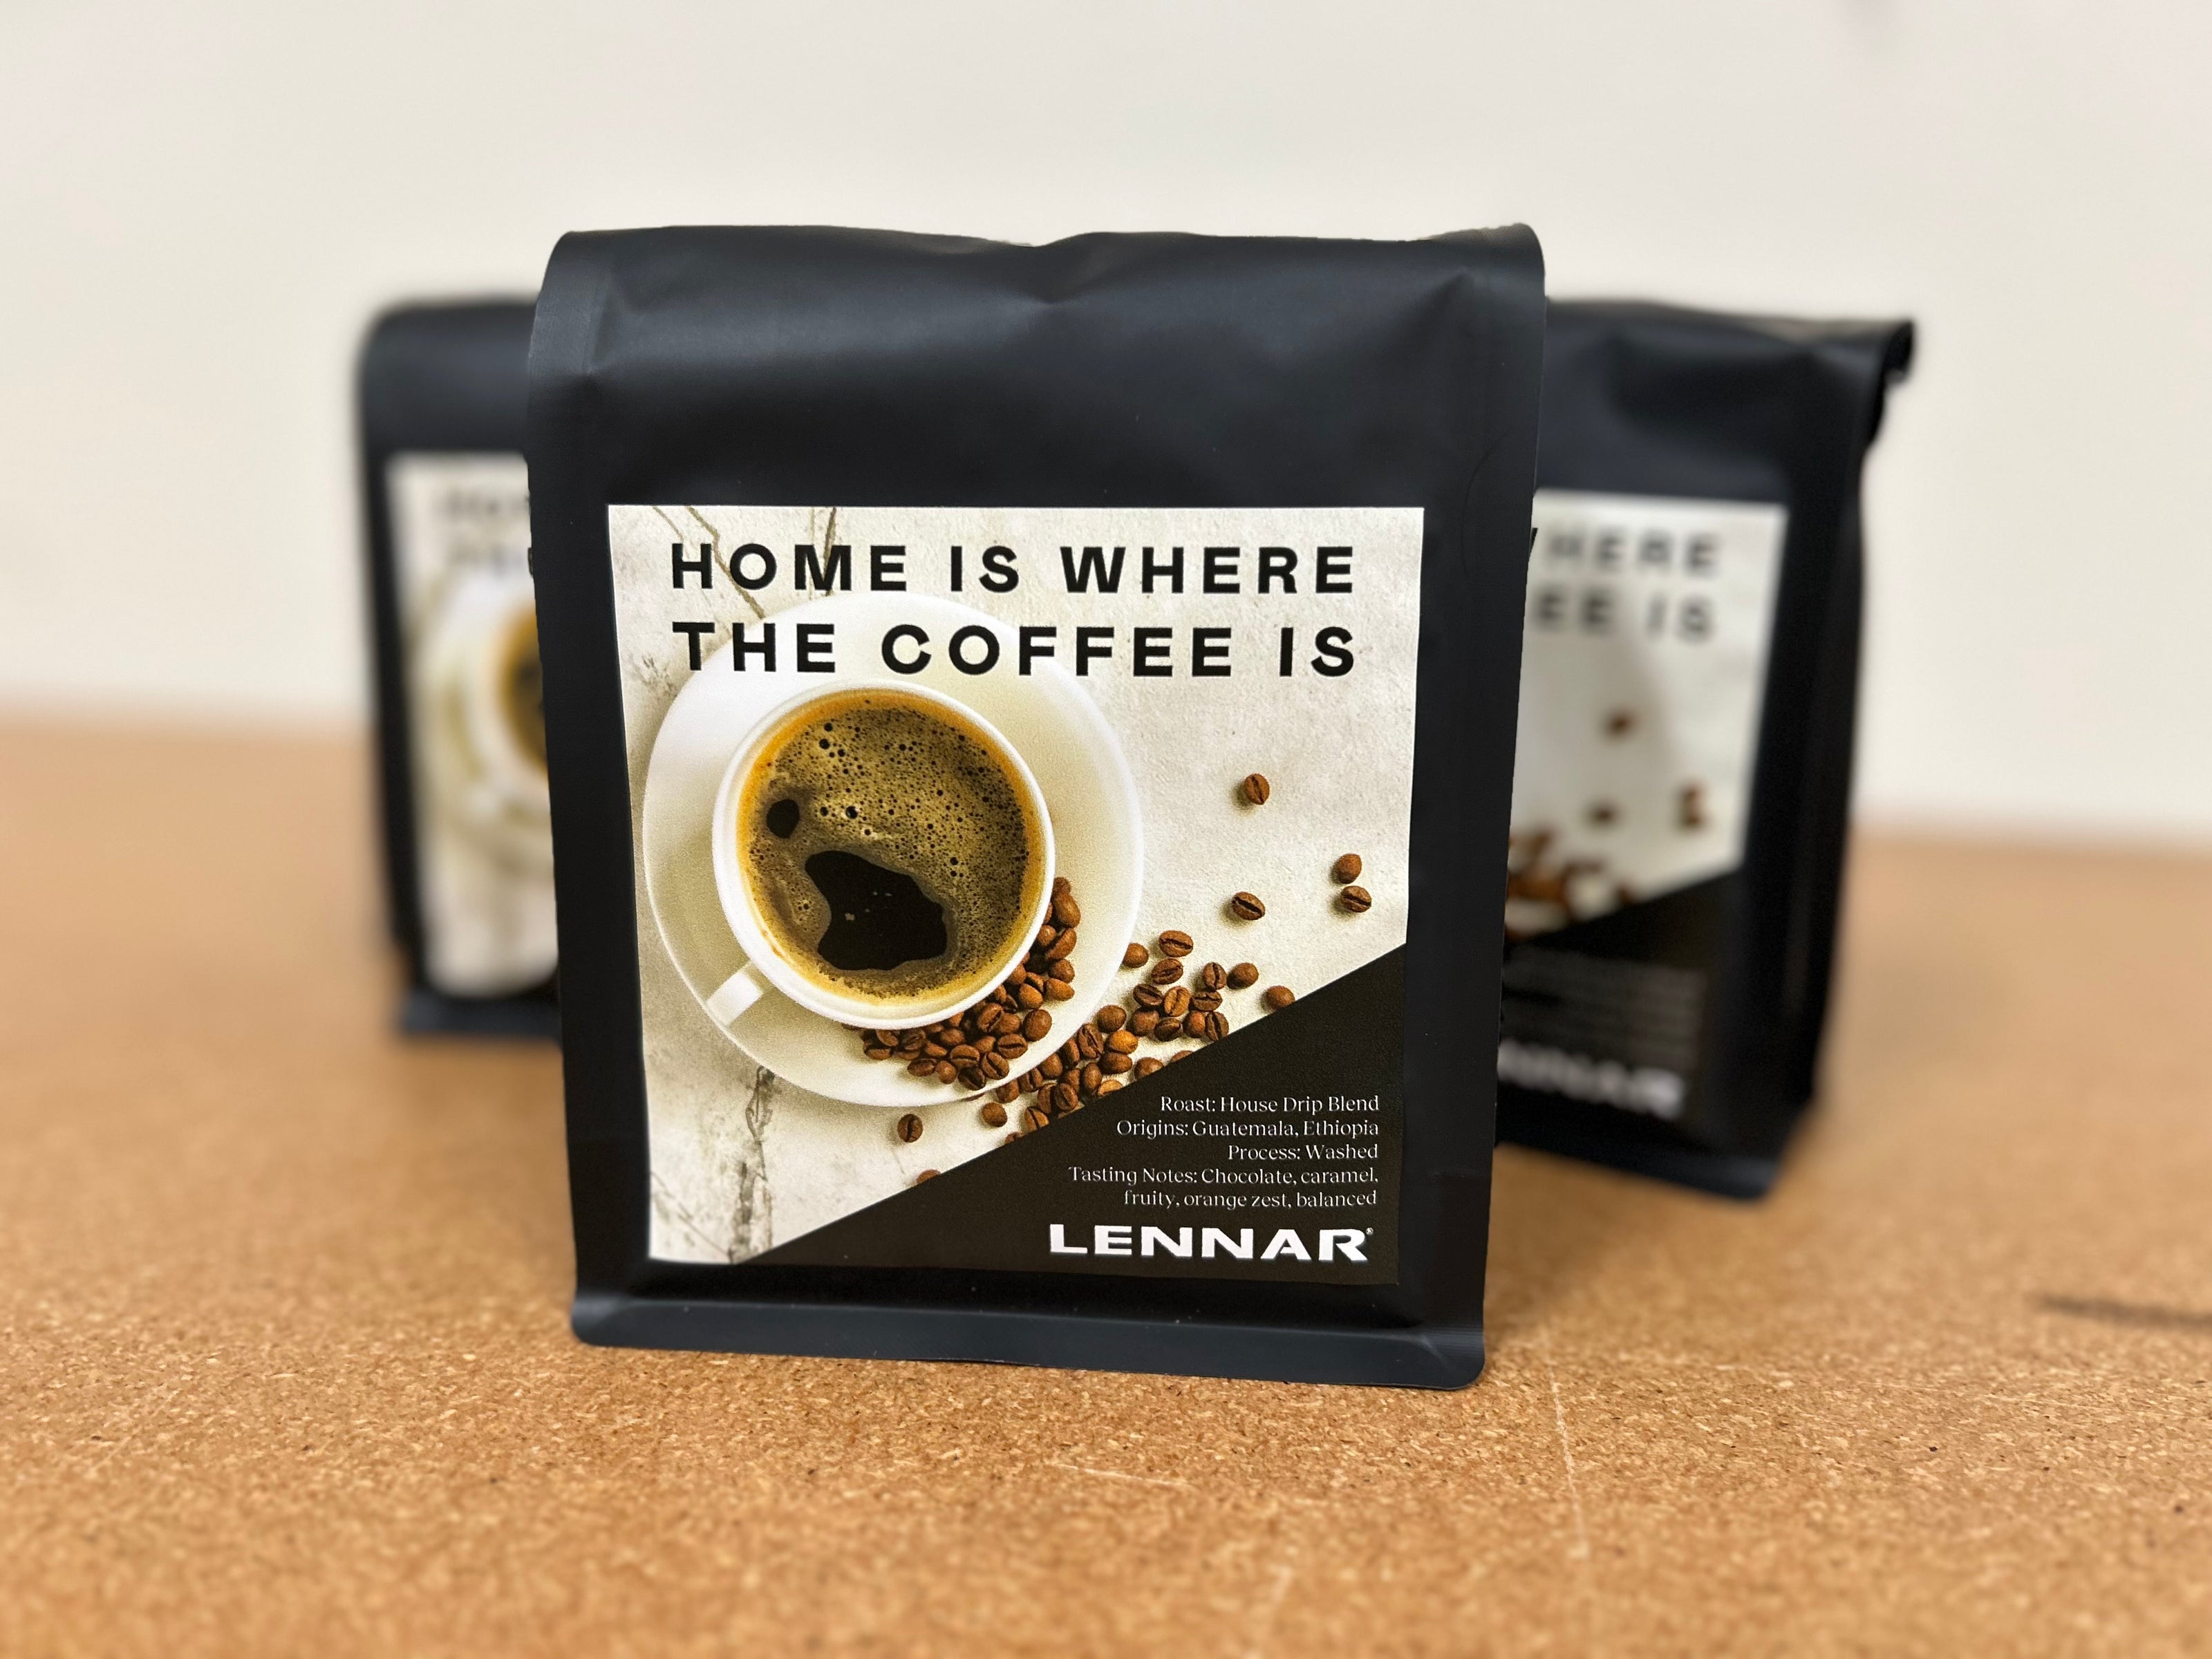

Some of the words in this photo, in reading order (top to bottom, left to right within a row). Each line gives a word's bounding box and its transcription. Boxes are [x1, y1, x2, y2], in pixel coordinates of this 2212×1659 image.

[1530, 527, 1720, 575] HERE
[672, 543, 906, 592] HOME
[950, 545, 1019, 592] IS
[1060, 546, 1353, 594] WHERE
[672, 621, 835, 673] THE
[881, 624, 1231, 677] COFFEE
[1280, 626, 1354, 677] IS
[1161, 1096, 1216, 1112] Roast:
[1221, 1096, 1278, 1113] House
[1283, 1096, 1323, 1116] Drip
[1329, 1095, 1380, 1112] Blend
[1116, 1119, 1188, 1140] Origins:
[1192, 1120, 1299, 1137] Guatemala,
[1304, 1119, 1378, 1139] Ethiopia
[1228, 1145, 1301, 1161] Process:
[1305, 1143, 1378, 1160] Washed
[1068, 1166, 1137, 1186] Tasting
[1143, 1168, 1197, 1183] Notes:
[1201, 1168, 1297, 1185] Chocolate,
[1300, 1167, 1378, 1184] caramel,
[1125, 1190, 1180, 1209] fruity,
[1183, 1194, 1247, 1210] orange
[1251, 1193, 1292, 1208] zest,
[1297, 1190, 1376, 1208] balanced
